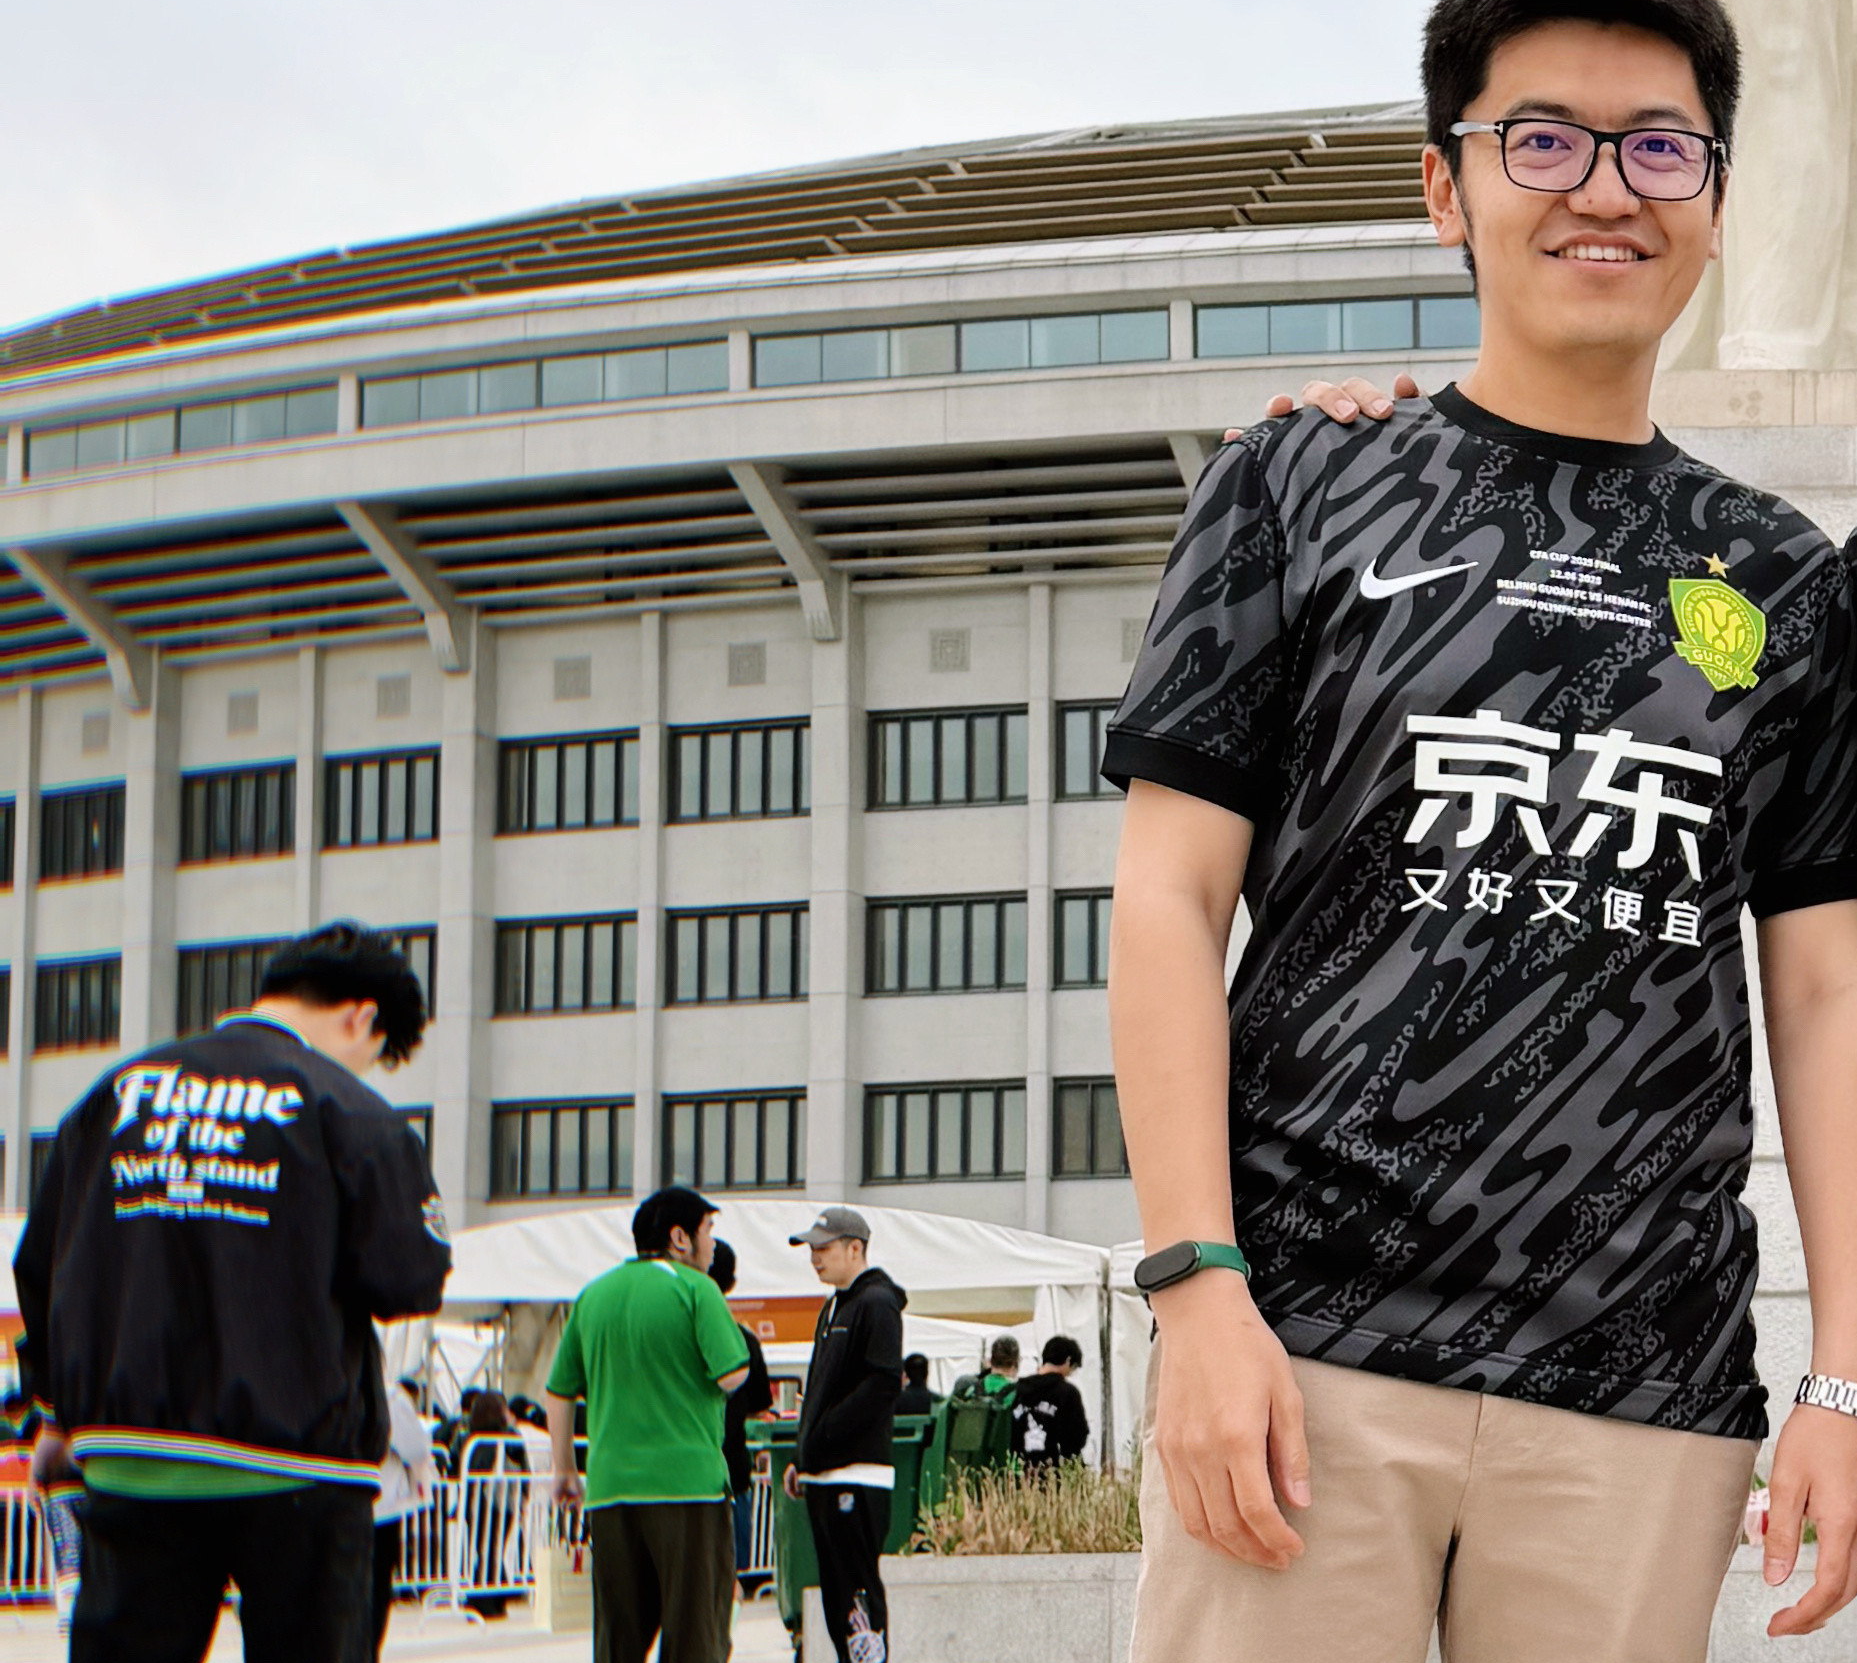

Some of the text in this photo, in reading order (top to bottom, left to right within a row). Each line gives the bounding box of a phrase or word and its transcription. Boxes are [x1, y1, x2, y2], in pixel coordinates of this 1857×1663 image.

[1529, 550, 1549, 561] CFA
[1549, 552, 1570, 563] CUP
[1574, 588, 1587, 600] FC
[1639, 601, 1652, 613] FC
[1692, 649, 1744, 680] GUOAN
[1402, 708, 1723, 882] 京东
[1401, 868, 1701, 947] 又好又便宜
[111, 1063, 304, 1137] Flame
[144, 1116, 246, 1155] of the
